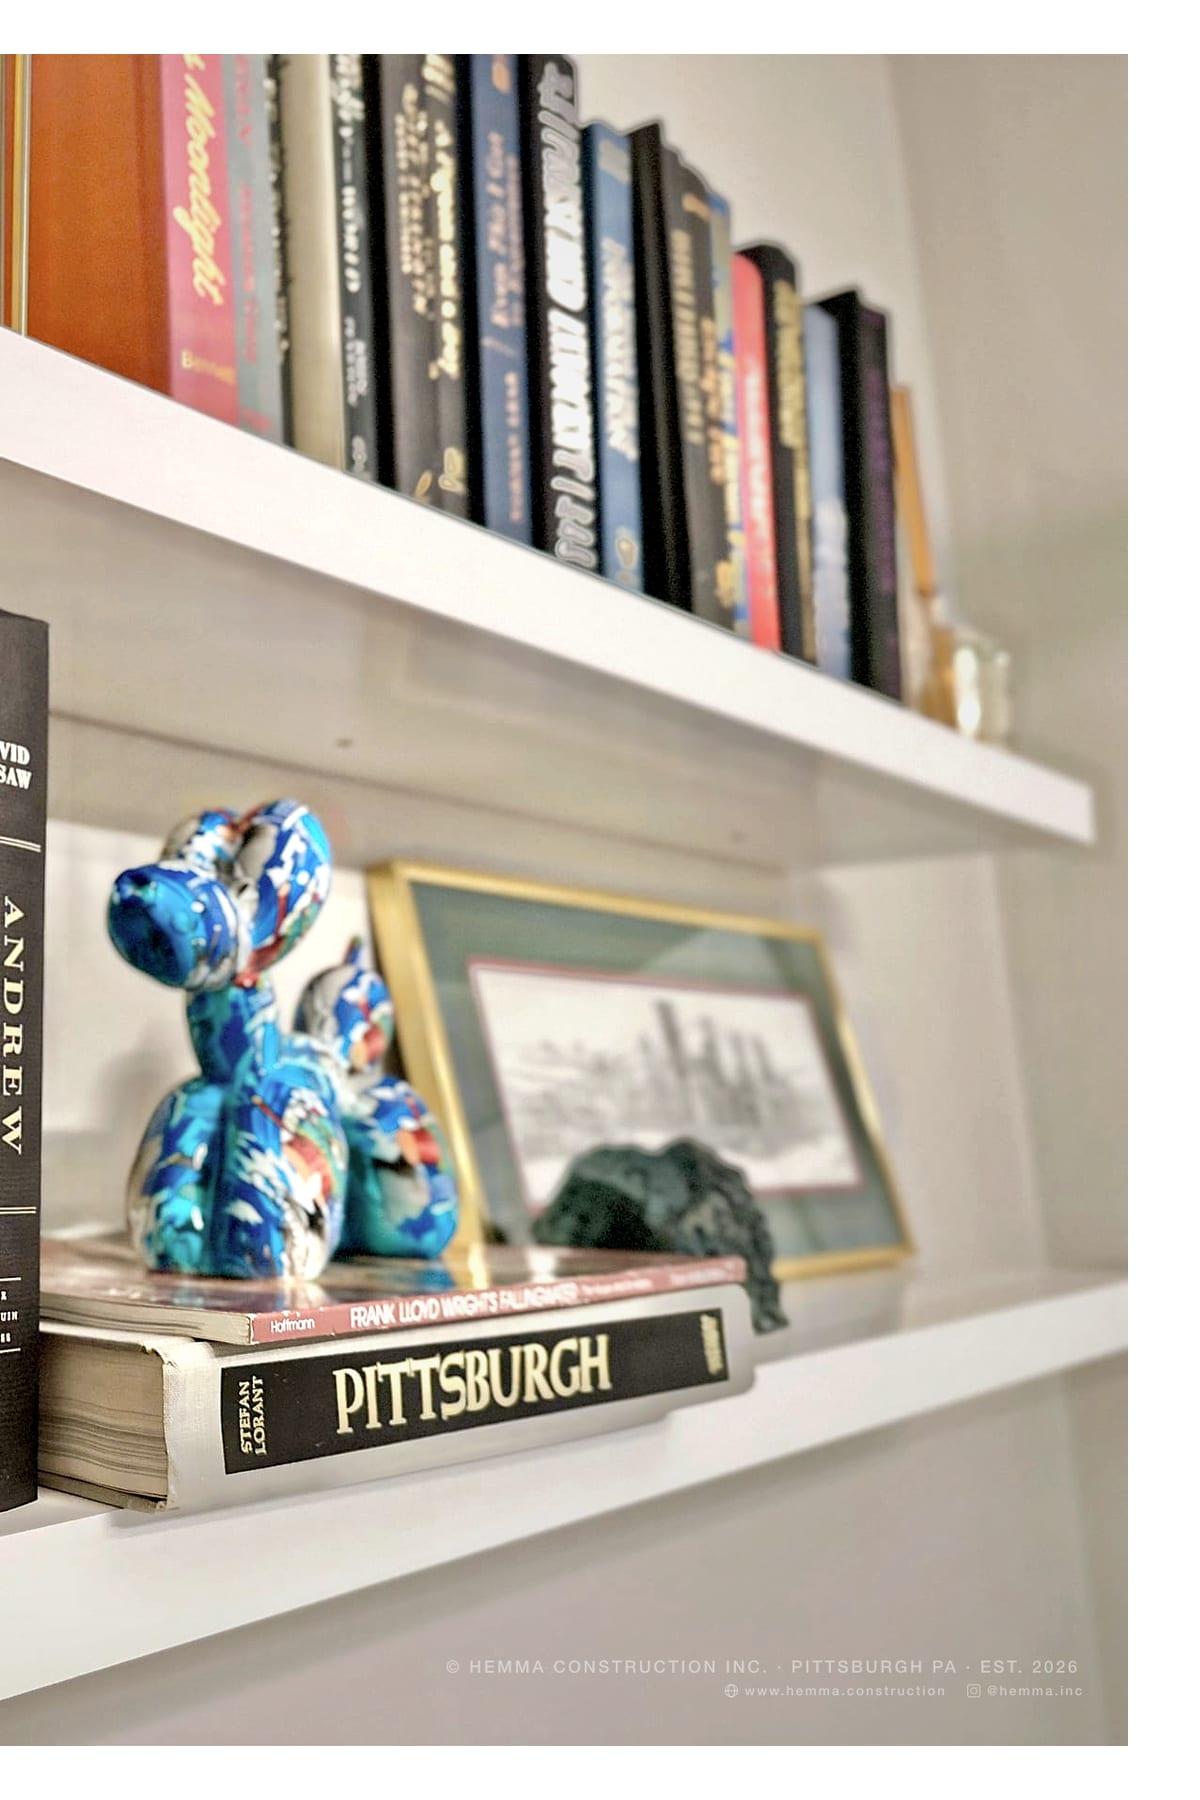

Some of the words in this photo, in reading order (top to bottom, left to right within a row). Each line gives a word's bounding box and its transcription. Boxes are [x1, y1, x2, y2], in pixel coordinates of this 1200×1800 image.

[172, 72, 227, 306] Moonlight
[1, 895, 25, 1156] ANDREW
[270, 1316, 316, 1334] Hoffmann
[350, 1305, 398, 1329] FRANK
[398, 1297, 441, 1323] LLOYD
[238, 1380, 254, 1455] STEFAN
[252, 1375, 268, 1456] LORANT
[332, 1334, 613, 1435] PITTSBURGH
